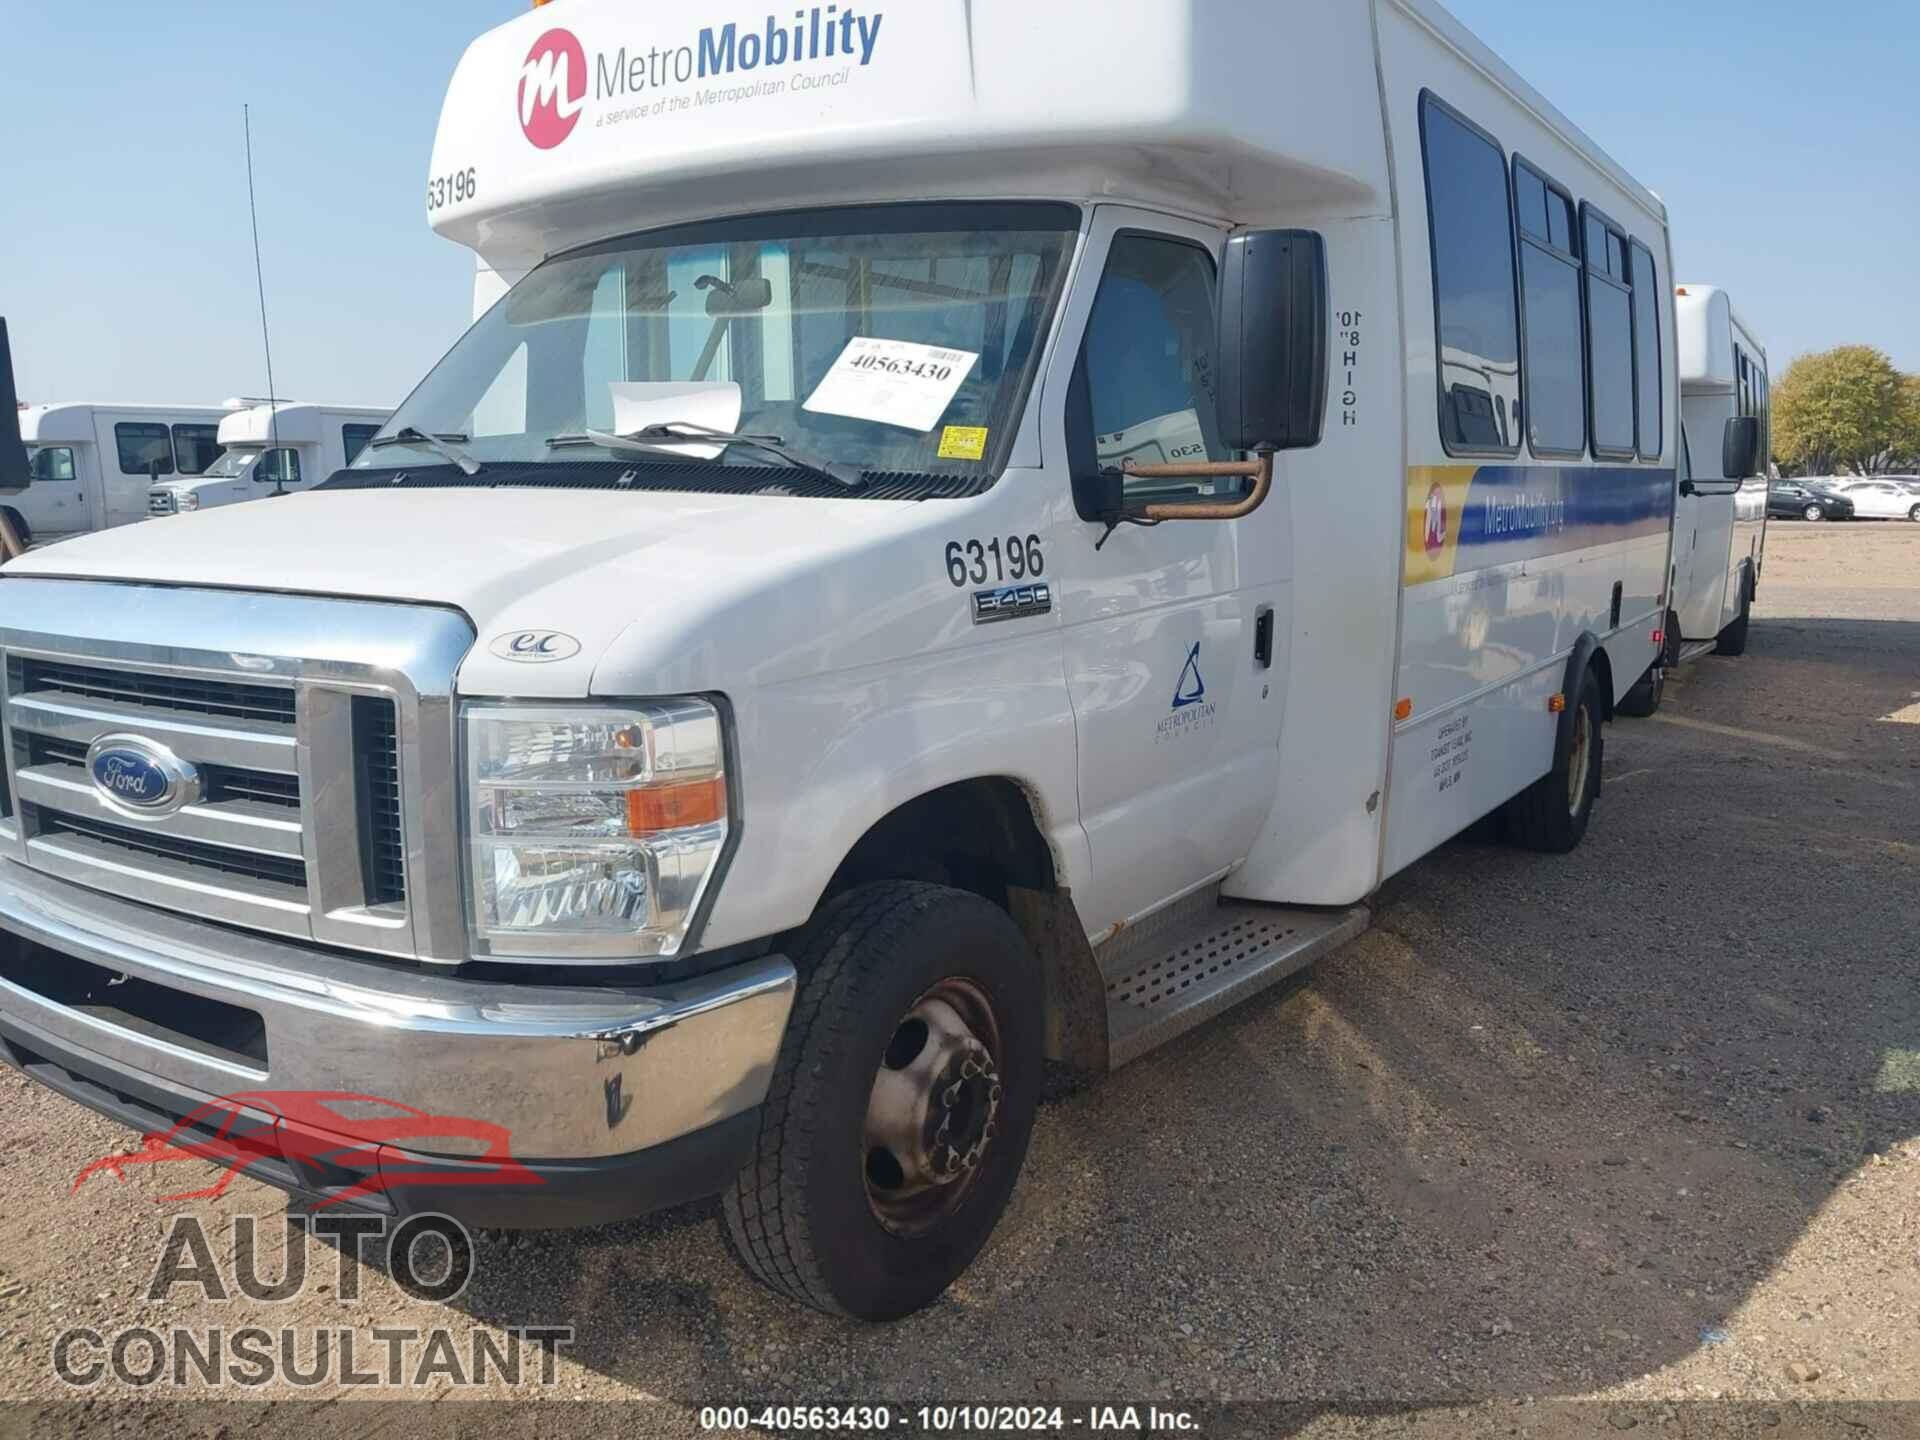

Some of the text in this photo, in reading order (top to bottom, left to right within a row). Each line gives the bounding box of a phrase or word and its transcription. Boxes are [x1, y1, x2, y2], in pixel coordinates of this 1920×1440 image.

[606, 105, 649, 125] service
[652, 97, 667, 115] of
[670, 95, 690, 111] the
[694, 79, 785, 107] Metropolitan
[791, 67, 850, 91] Council
[428, 166, 476, 211] 63196
[850, 353, 952, 382] 40563430
[945, 534, 1044, 587] 63196
[104, 757, 147, 793] Ford
